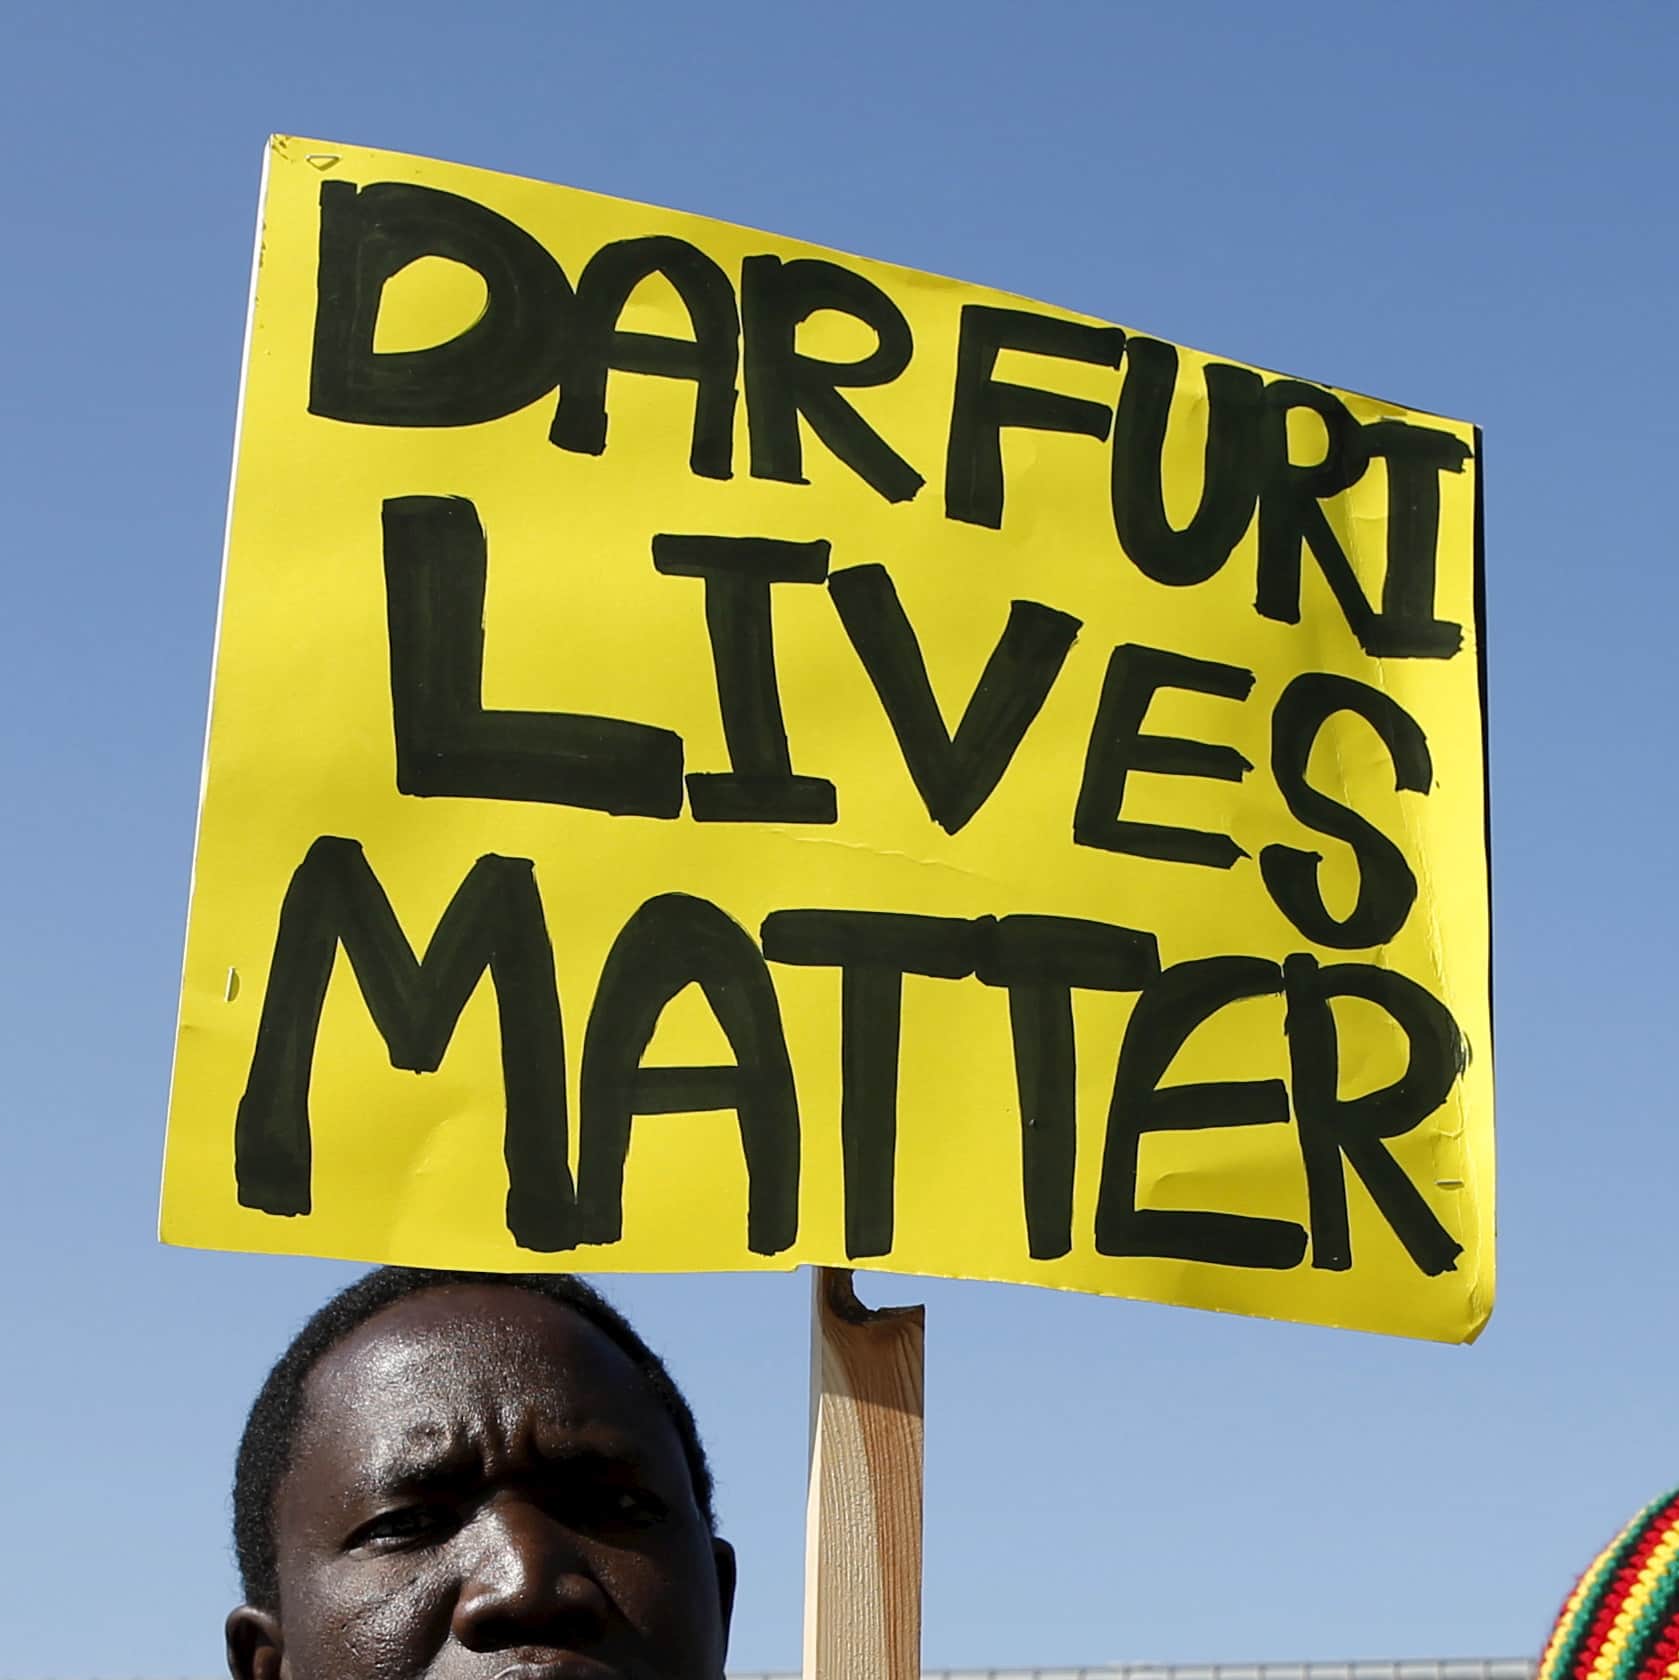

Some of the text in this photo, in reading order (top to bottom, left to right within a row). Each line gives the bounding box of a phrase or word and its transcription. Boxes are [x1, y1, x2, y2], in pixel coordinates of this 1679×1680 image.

[308, 181, 1473, 659] DARFURI
[382, 495, 1436, 949] LIVES
[235, 836, 1470, 1277] MATTER
